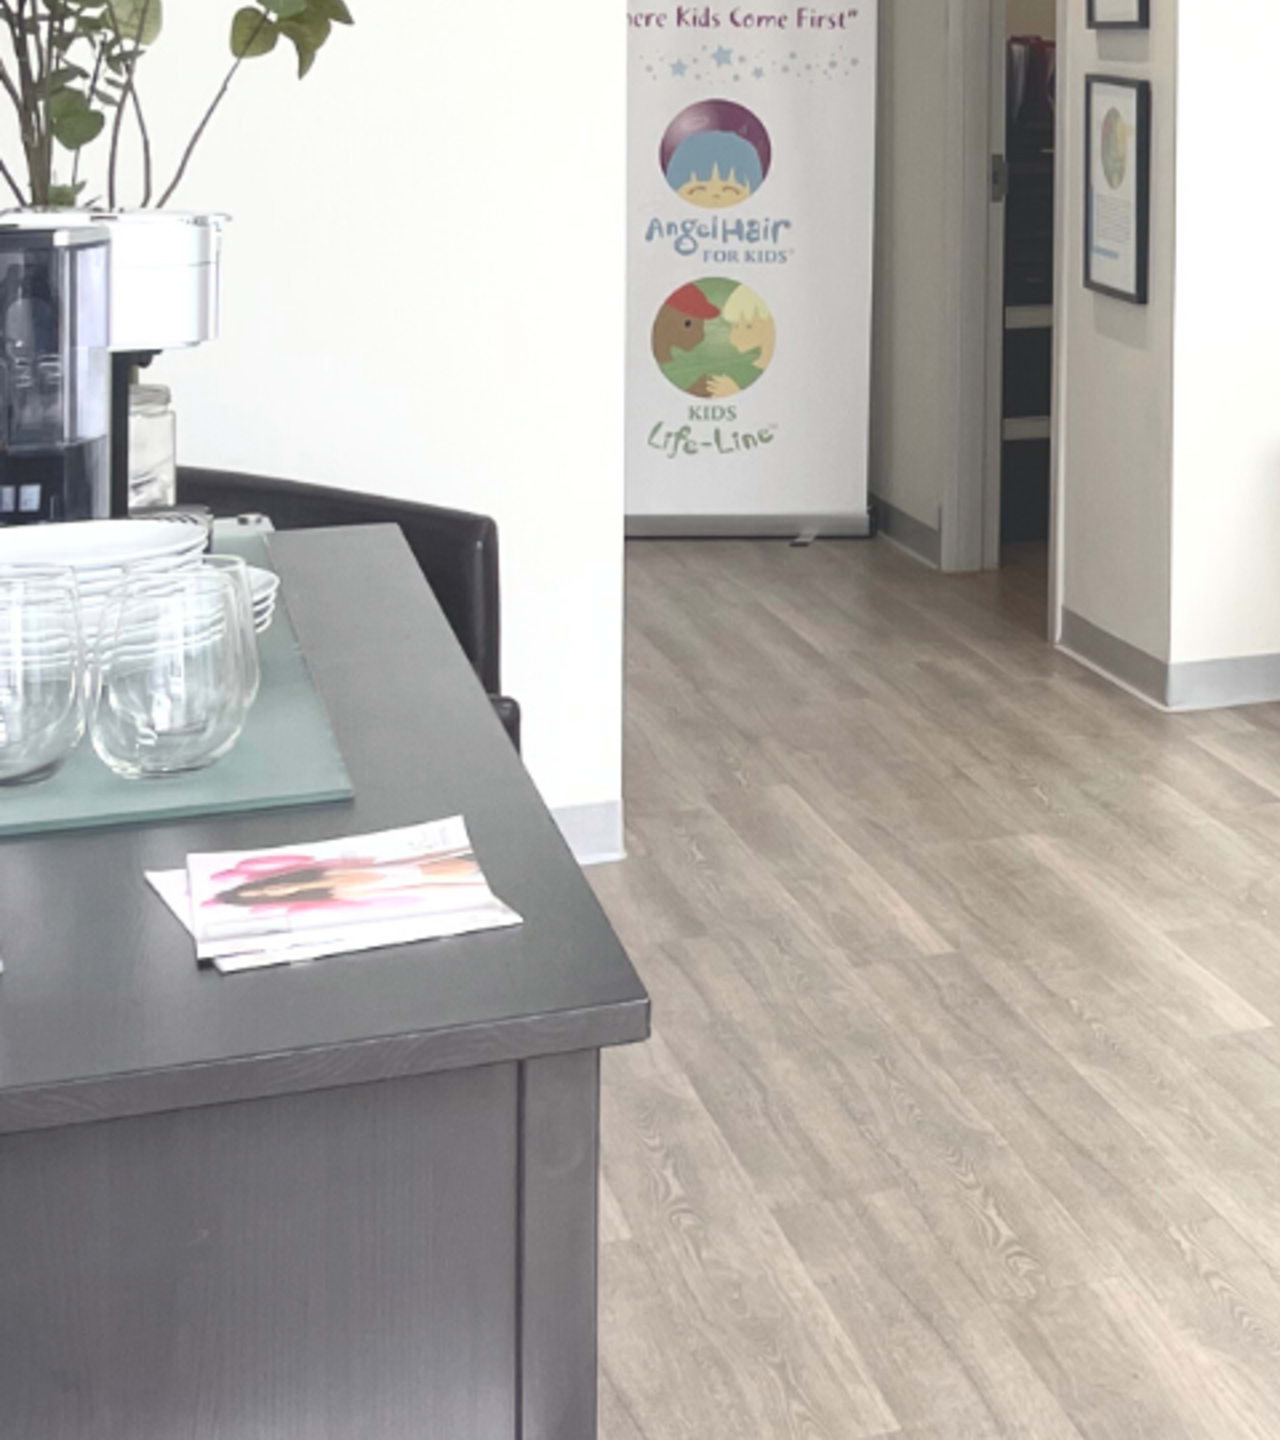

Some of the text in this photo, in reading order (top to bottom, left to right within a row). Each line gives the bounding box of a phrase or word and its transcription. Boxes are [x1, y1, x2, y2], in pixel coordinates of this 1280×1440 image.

[676, 5, 721, 28] Kids
[729, 6, 788, 29] Come
[702, 249, 788, 264] FOR KIDS
[688, 405, 737, 421] KIDS
